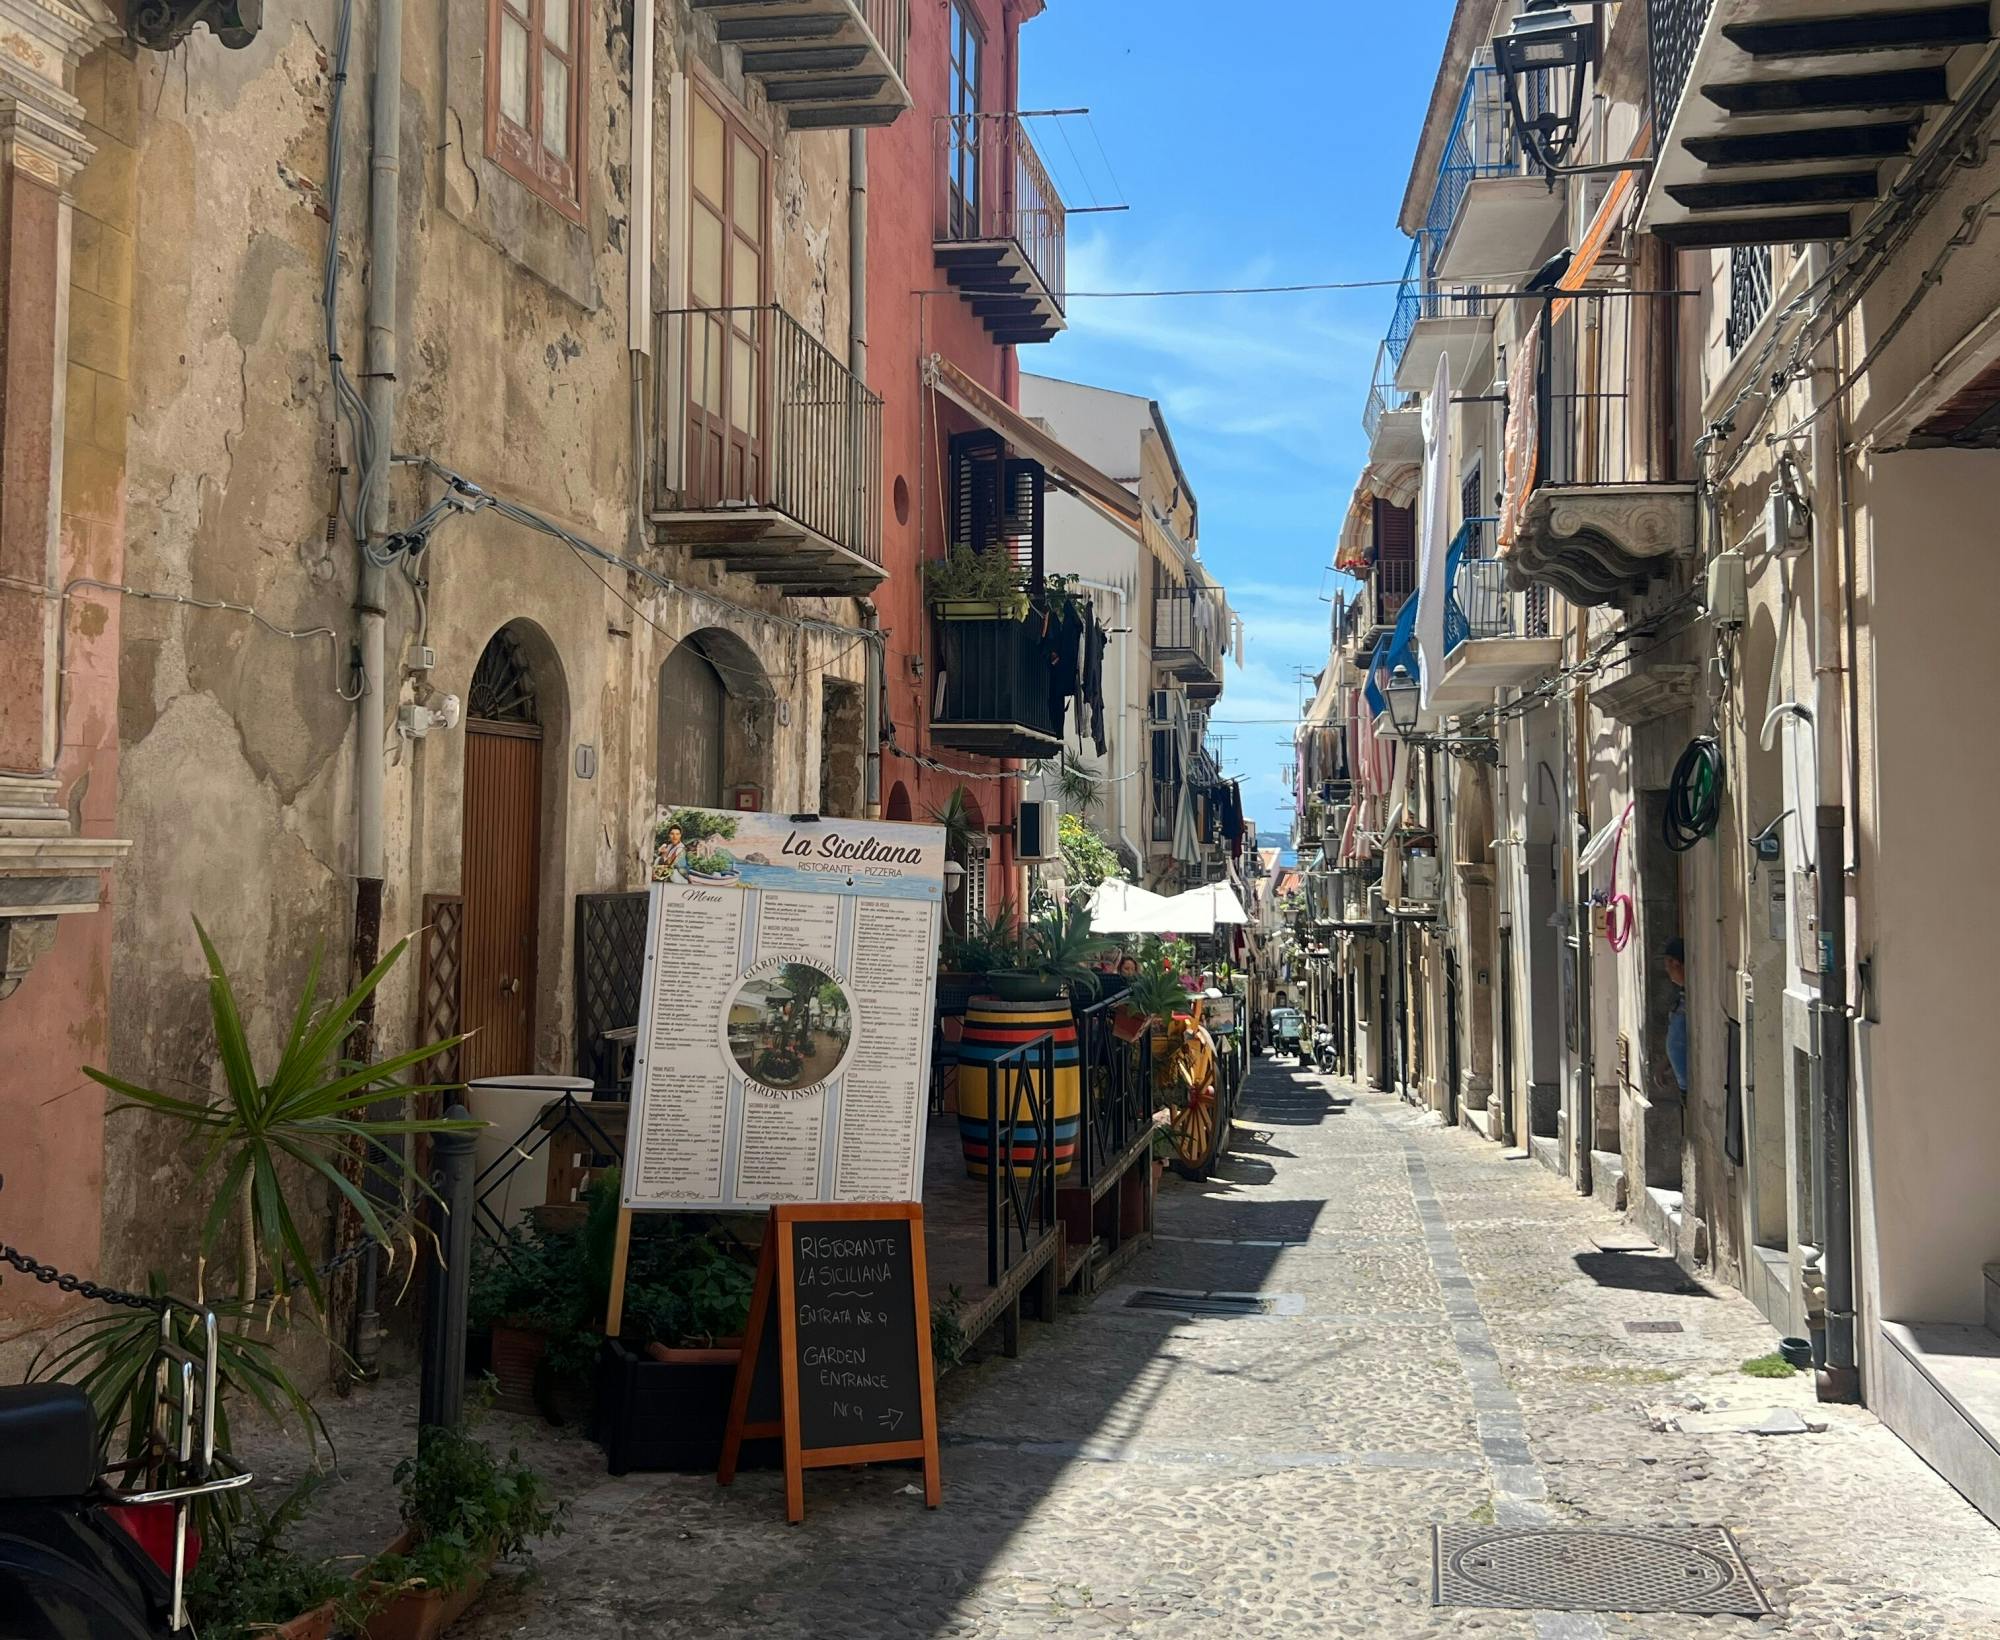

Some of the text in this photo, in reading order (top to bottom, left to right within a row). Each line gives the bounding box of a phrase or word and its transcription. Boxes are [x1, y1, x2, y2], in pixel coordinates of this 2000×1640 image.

[782, 830, 922, 865] La Siciliana
[798, 861, 852, 875] RISTORANTE
[864, 866, 903, 878] PIZZERIA
[682, 889, 723, 903] Menu
[743, 954, 798, 981] GIARDINO
[800, 955, 845, 985] INTERNO
[743, 1077, 789, 1101] GARDEN
[791, 1080, 829, 1100] INSIDE
[800, 1236, 896, 1259] RISTORANTE
[799, 1262, 892, 1286] LA SICILIANA
[799, 1304, 851, 1327] ENTRATA
[878, 1311, 888, 1327] 9
[803, 1346, 866, 1366] GARDEN
[820, 1368, 889, 1389] ENTRANCE
[853, 1405, 863, 1421] 9
